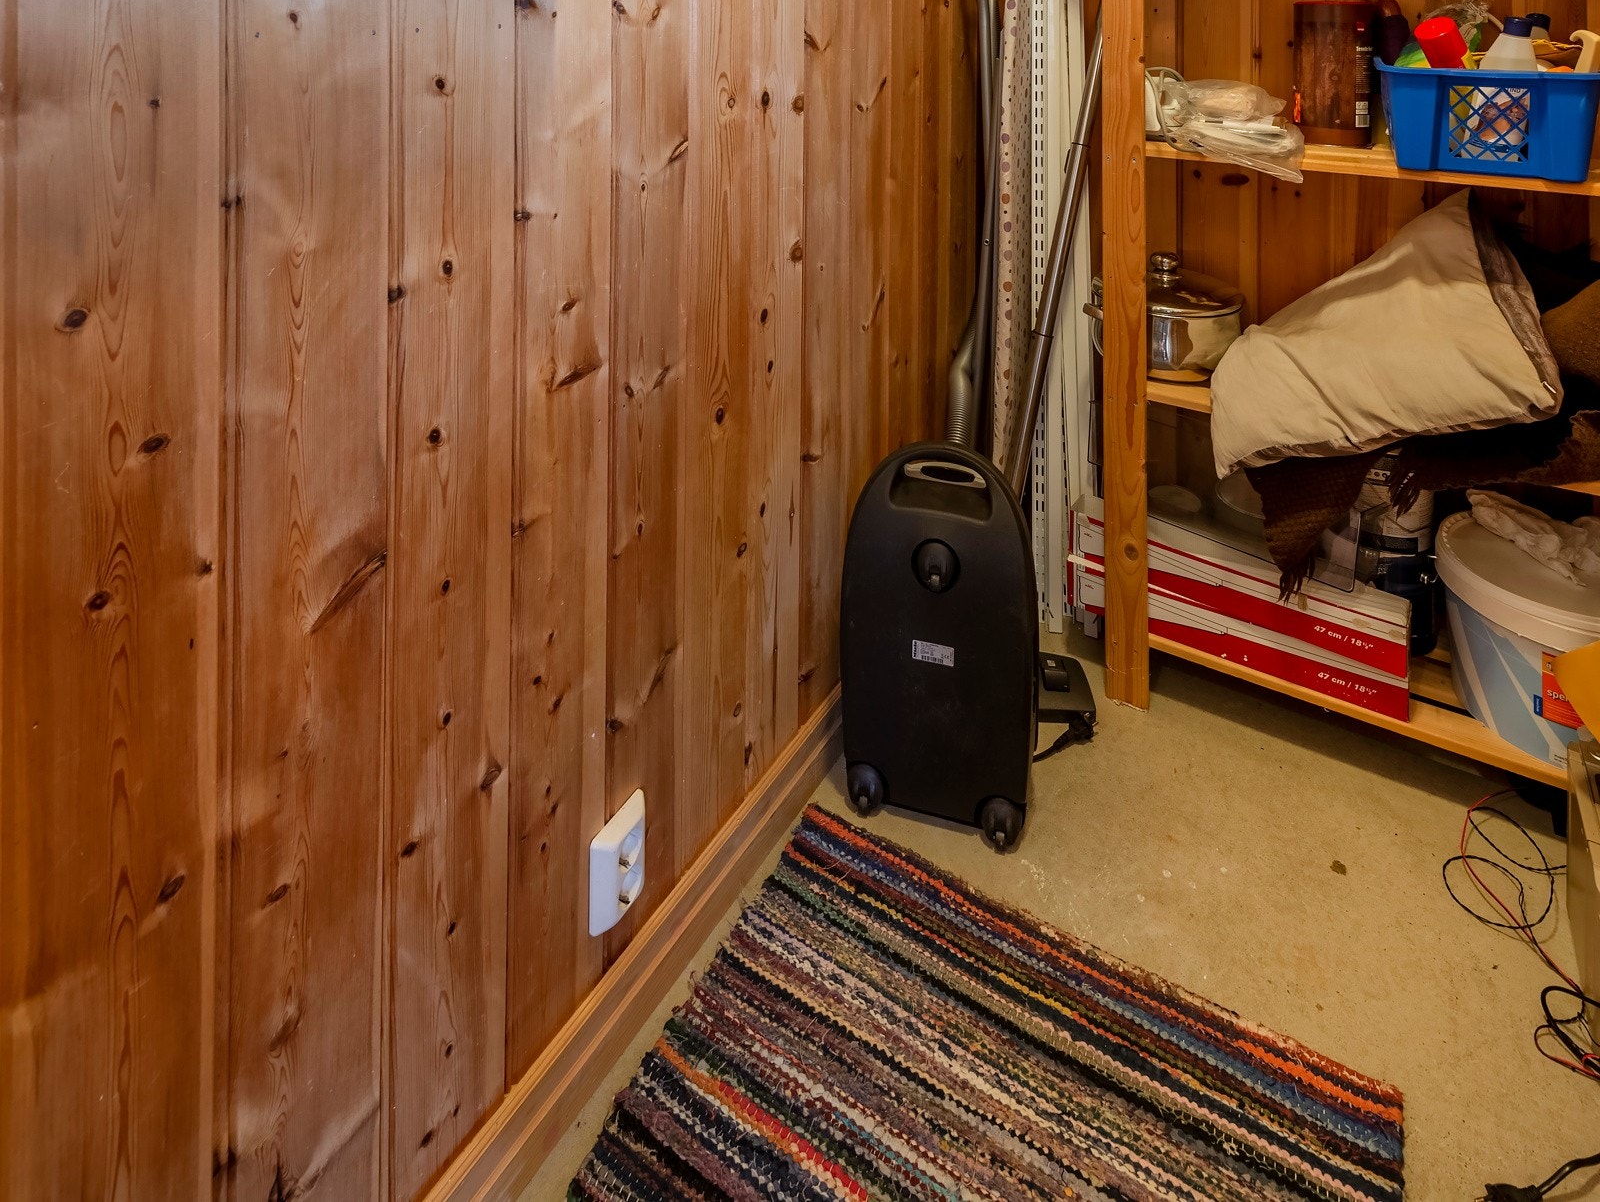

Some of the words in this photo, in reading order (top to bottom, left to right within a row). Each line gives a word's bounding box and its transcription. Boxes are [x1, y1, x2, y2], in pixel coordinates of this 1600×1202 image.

[1313, 625, 1326, 633] 47
[1327, 630, 1342, 640] cm
[1317, 672, 1330, 680] 47
[1331, 677, 1346, 686] cm
